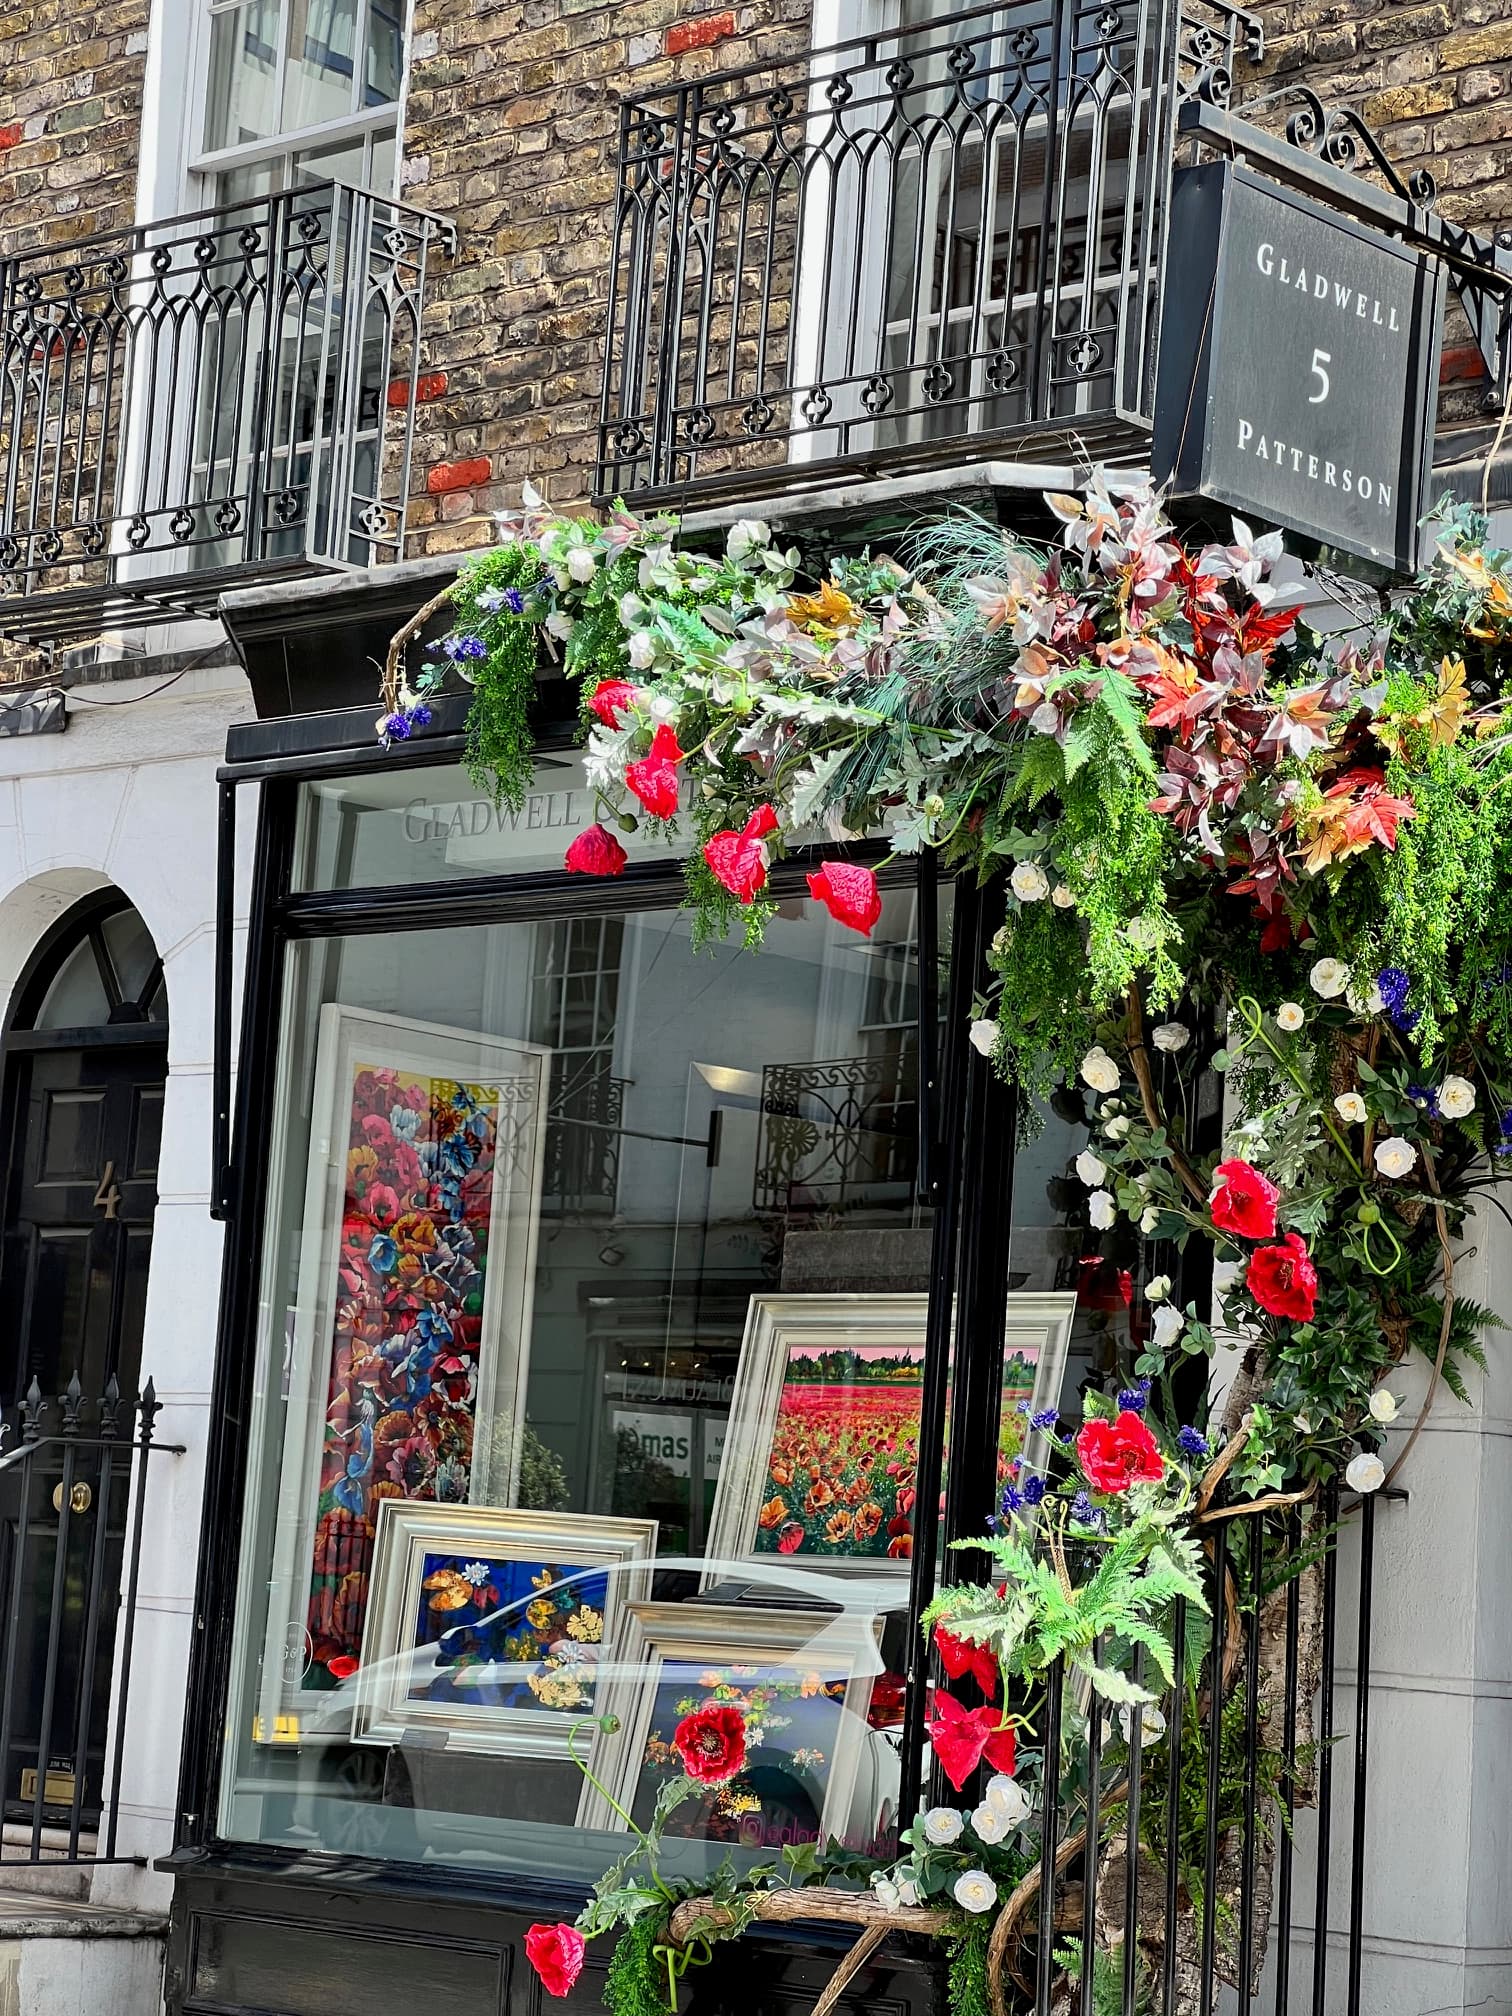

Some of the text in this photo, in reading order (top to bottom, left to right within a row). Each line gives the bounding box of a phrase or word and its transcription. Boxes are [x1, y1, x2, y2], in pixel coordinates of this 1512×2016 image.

[1256, 243, 1400, 332] GLADWELL
[1308, 348, 1332, 404] 5
[1237, 418, 1393, 508] PATTERSON
[404, 790, 581, 844] GLADWELL
[93, 1161, 122, 1219] 4
